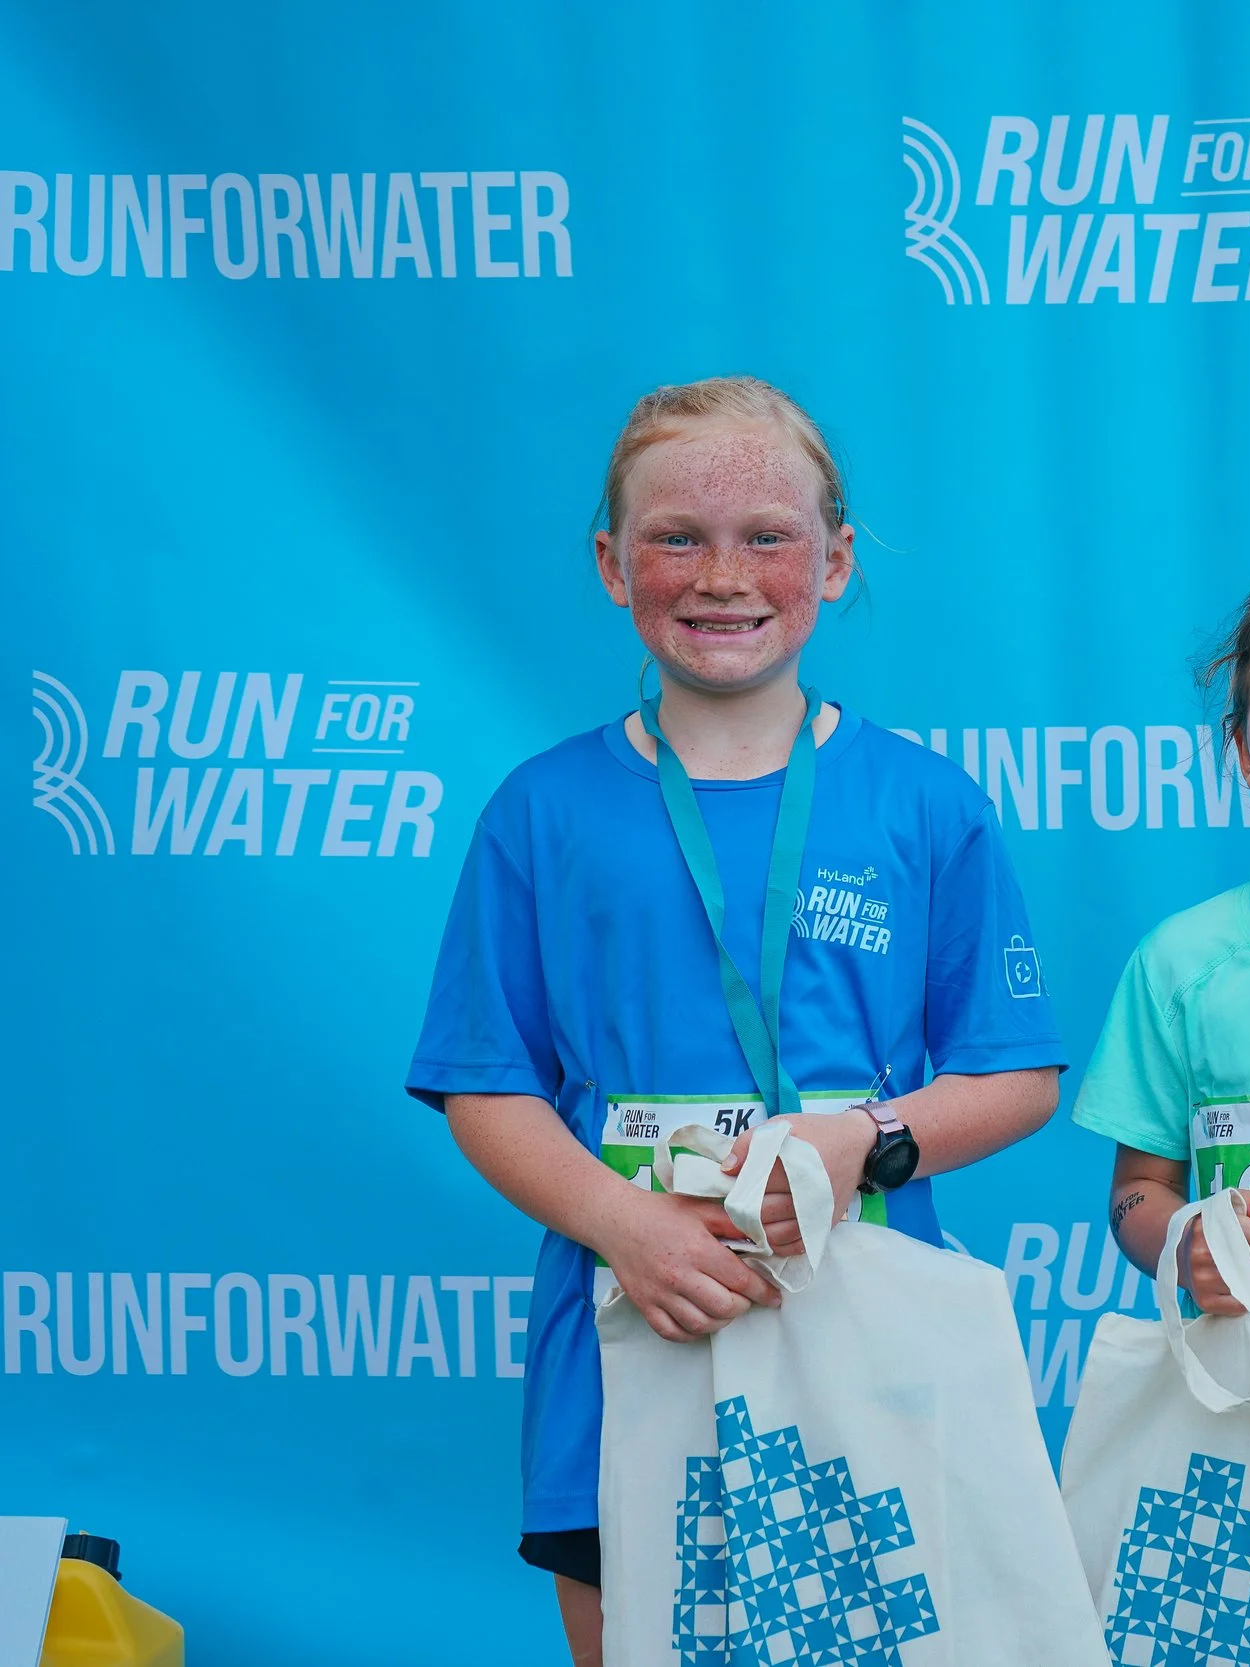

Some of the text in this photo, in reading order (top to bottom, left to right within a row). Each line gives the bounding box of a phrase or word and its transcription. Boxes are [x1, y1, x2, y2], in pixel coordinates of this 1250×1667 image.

[975, 114, 1170, 206] RUN
[0, 170, 573, 279] RUNFORWATER
[102, 670, 414, 759] RUN FOR
[131, 768, 444, 857] WATER
[817, 867, 865, 886] HyLand
[807, 886, 889, 921] RUN FOR
[811, 914, 892, 955] WATER
[624, 1108, 756, 1137] RUN FOR 5K
[625, 1123, 660, 1138] WATER
[1206, 1110, 1220, 1124] RUN
[1219, 1112, 1230, 1121] FOR
